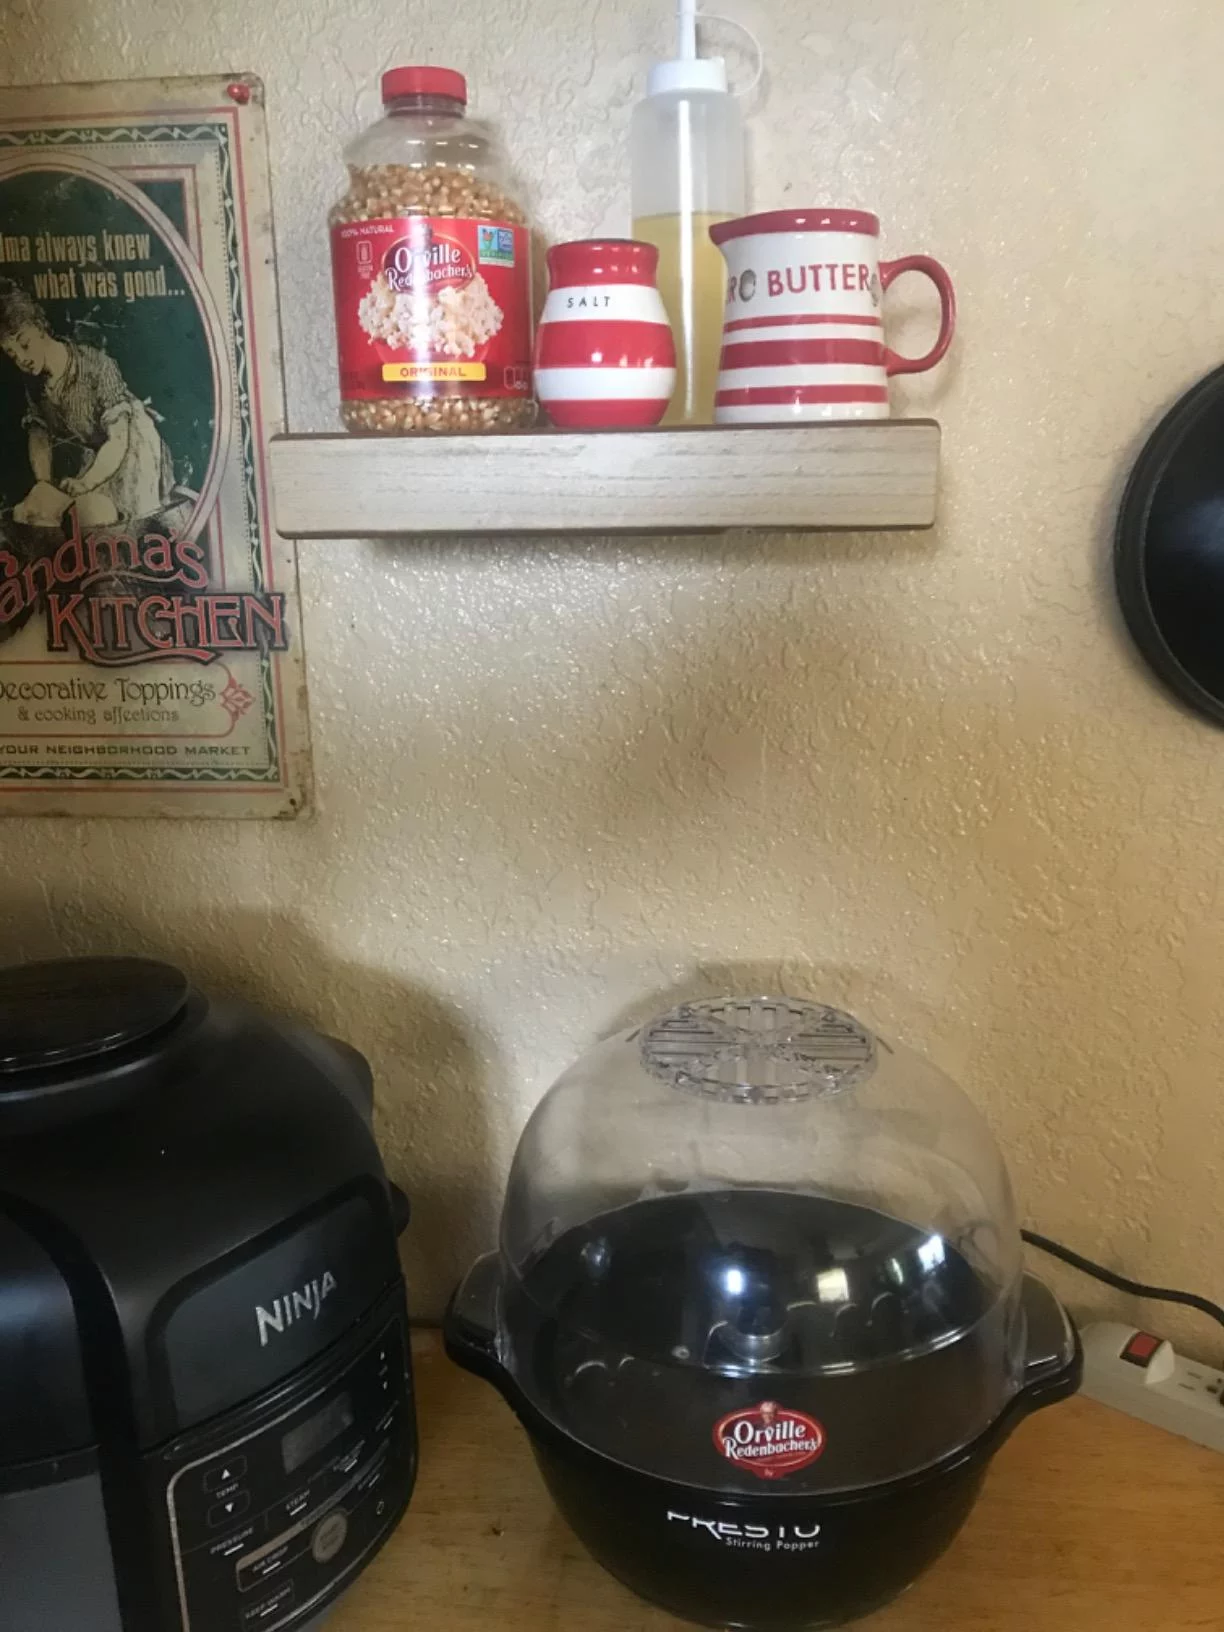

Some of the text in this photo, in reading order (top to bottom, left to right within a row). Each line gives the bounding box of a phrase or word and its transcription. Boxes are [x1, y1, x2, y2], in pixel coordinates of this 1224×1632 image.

[36, 232, 97, 267] always
[102, 229, 150, 261] knew
[34, 267, 78, 299] what
[82, 271, 118, 298] was
[385, 264, 472, 291] Redbacher's
[767, 263, 870, 297] BUTTER
[567, 296, 612, 308] SALT
[48, 592, 287, 666] KITCHEN
[114, 678, 217, 706] Toppings
[18, 707, 180, 724] & cooking affections
[47, 745, 177, 755] NEIGHBORHOOD
[185, 746, 251, 756] MARKET
[255, 1269, 338, 1347] NINJA
[734, 1420, 806, 1444] Orville
[725, 1537, 820, 1552] Stirring Popper
